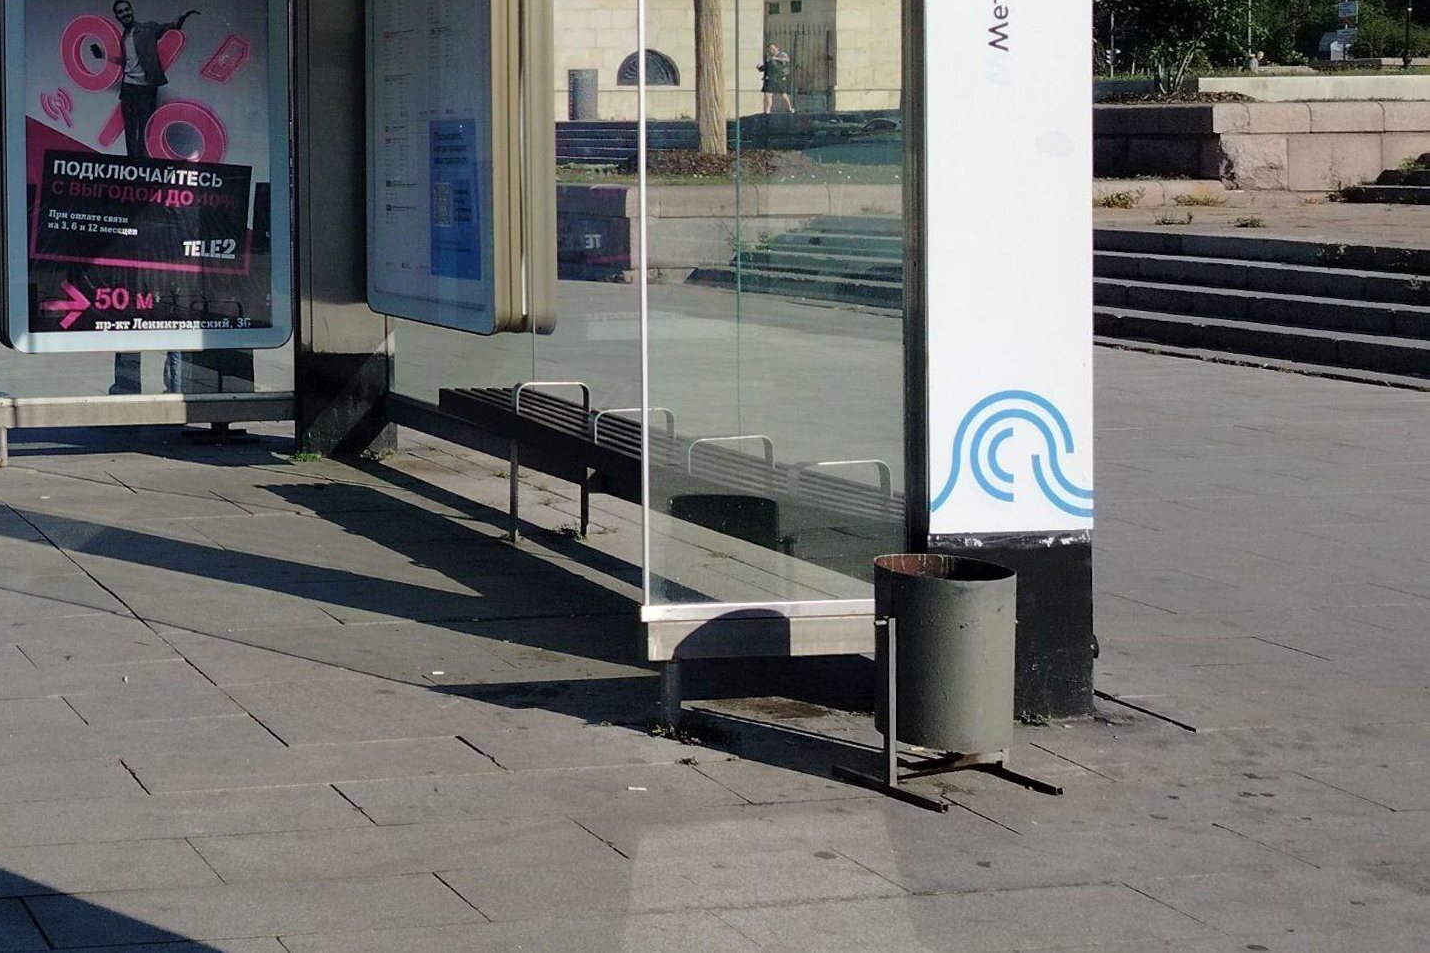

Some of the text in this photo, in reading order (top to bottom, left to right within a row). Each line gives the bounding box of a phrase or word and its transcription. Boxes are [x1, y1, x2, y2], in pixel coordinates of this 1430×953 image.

[53, 159, 223, 188] ПОДКЛЮЧАЙТЕСЬ
[52, 181, 64, 194] С
[70, 182, 162, 203] ВЫГОДОЙ
[165, 189, 194, 207] ДО
[48, 209, 129, 224] При оплате связи
[60, 221, 70, 231] 3,
[71, 222, 78, 231] 6
[88, 223, 98, 233] 12
[100, 226, 138, 237] месяцев
[183, 238, 236, 260] TELE2
[94, 287, 130, 310] 50
[95, 318, 131, 331] пр-кт
[132, 317, 233, 330] Ленинградский,
